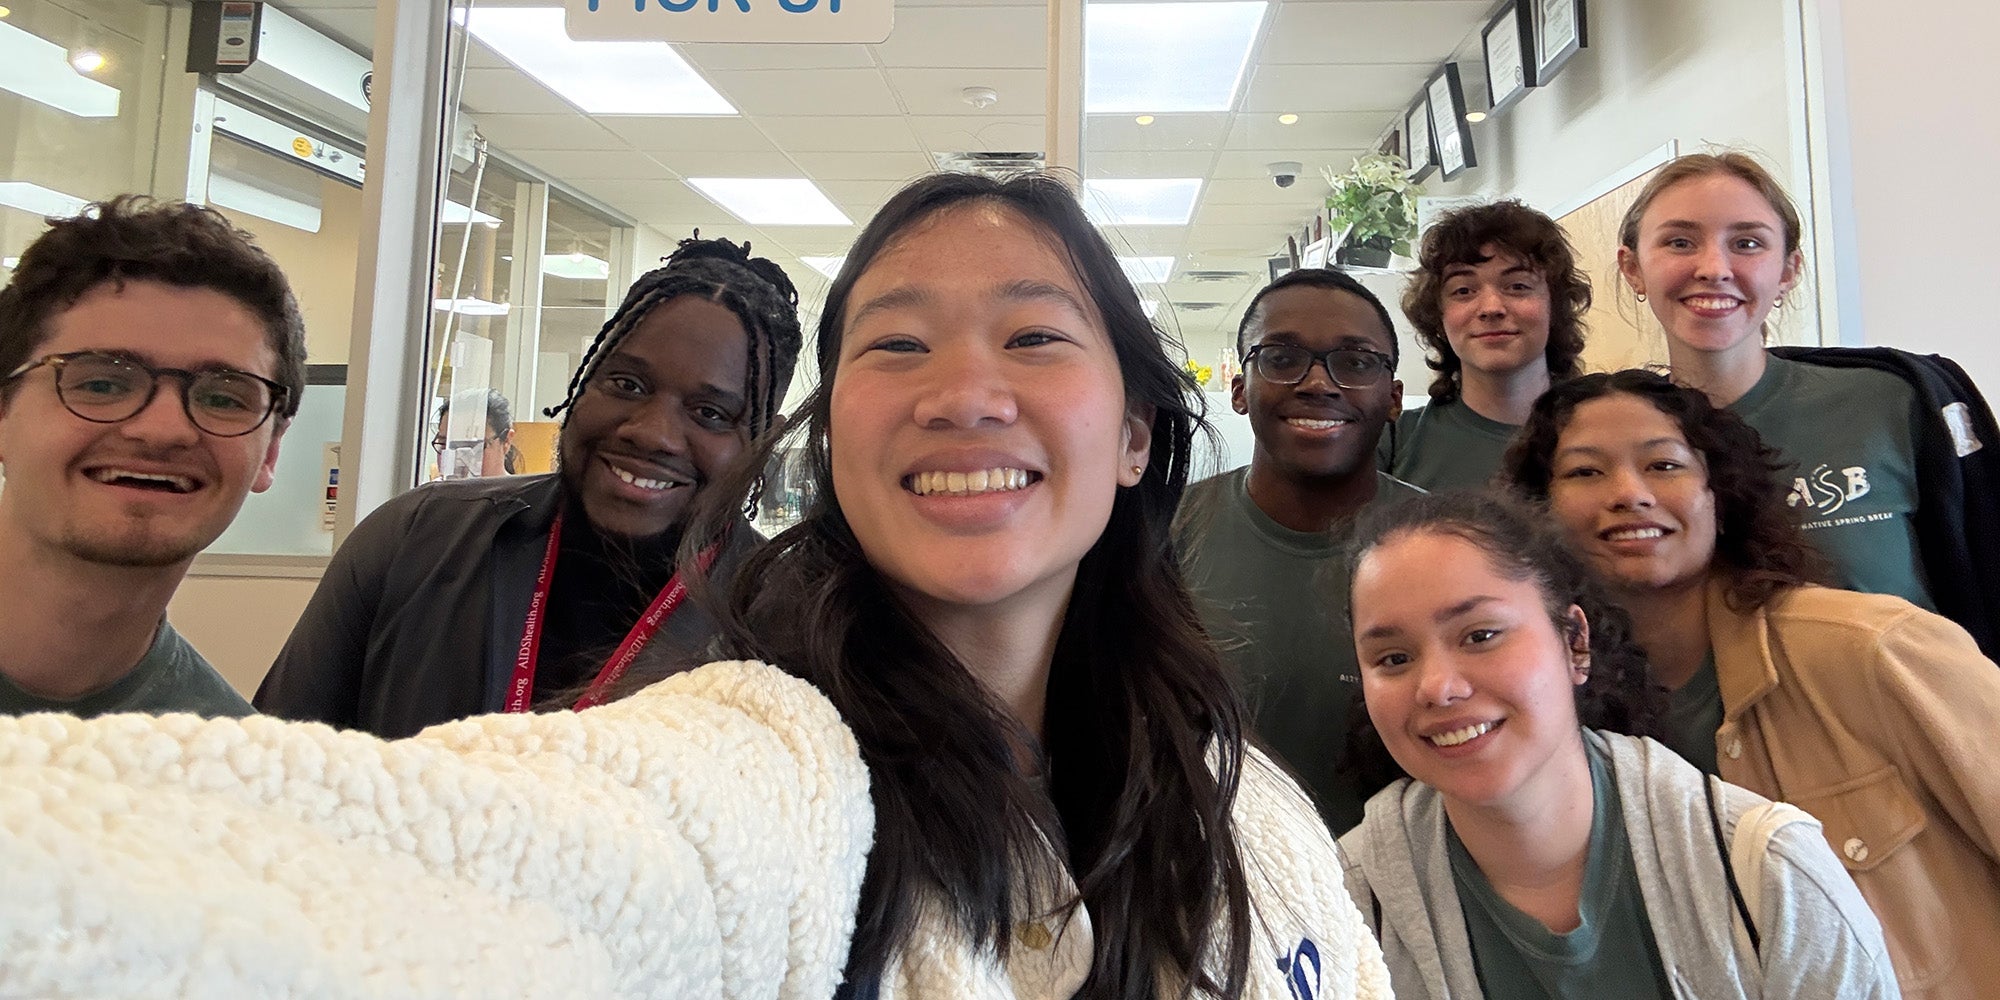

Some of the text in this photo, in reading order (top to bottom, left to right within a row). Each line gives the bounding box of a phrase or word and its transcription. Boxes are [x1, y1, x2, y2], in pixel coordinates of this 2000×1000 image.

[1834, 515, 1867, 527] SPRING
[1867, 512, 1894, 522] BREAK
[517, 591, 544, 670] AIDShealth.org
[511, 677, 528, 713] th.org
